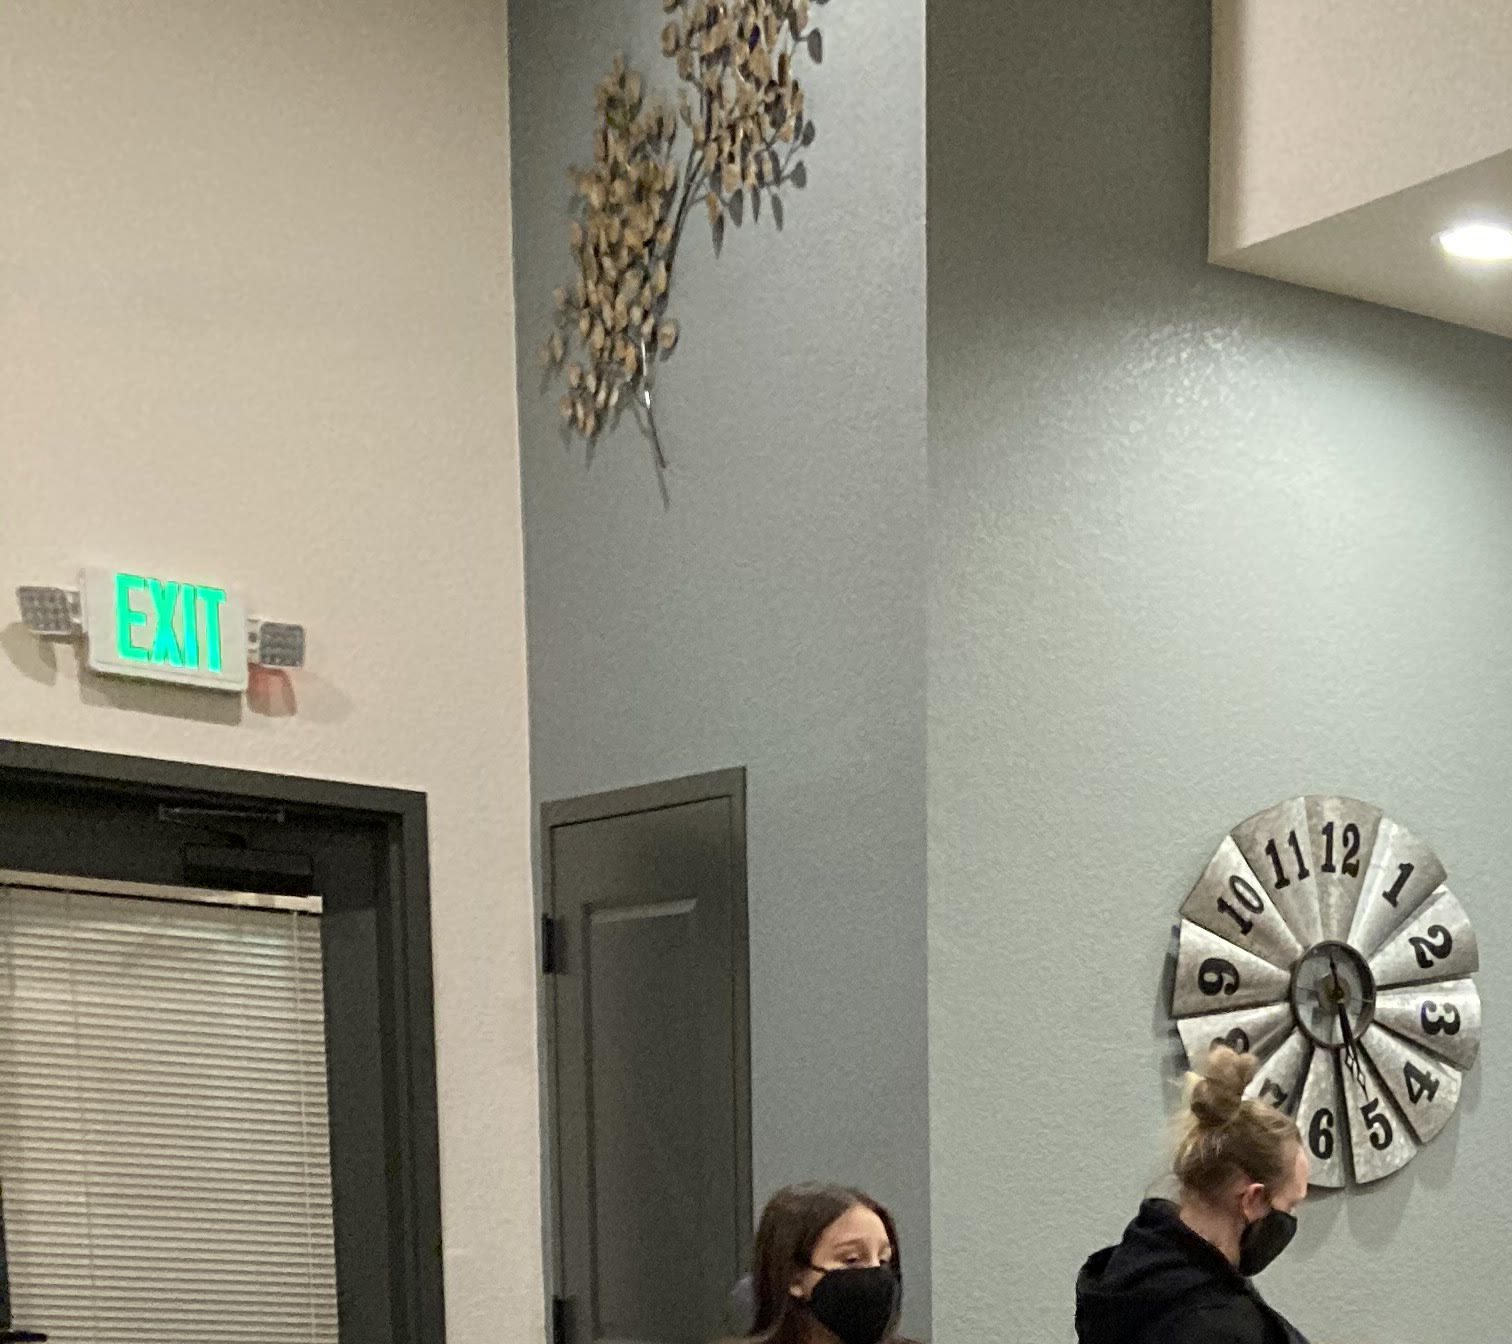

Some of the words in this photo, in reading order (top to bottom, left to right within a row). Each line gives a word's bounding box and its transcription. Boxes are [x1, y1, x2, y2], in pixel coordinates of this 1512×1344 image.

[114, 573, 227, 673] EXIT
[1264, 829, 1311, 890] 11
[1320, 821, 1361, 878] 12
[1216, 874, 1265, 936] 10
[1382, 862, 1415, 908] 1
[1408, 924, 1454, 970] 2
[1197, 956, 1241, 997] 9
[1420, 1000, 1462, 1037] 3
[1402, 1061, 1441, 1106] 4
[1308, 1107, 1335, 1160] 6
[1360, 1097, 1394, 1151] 5
